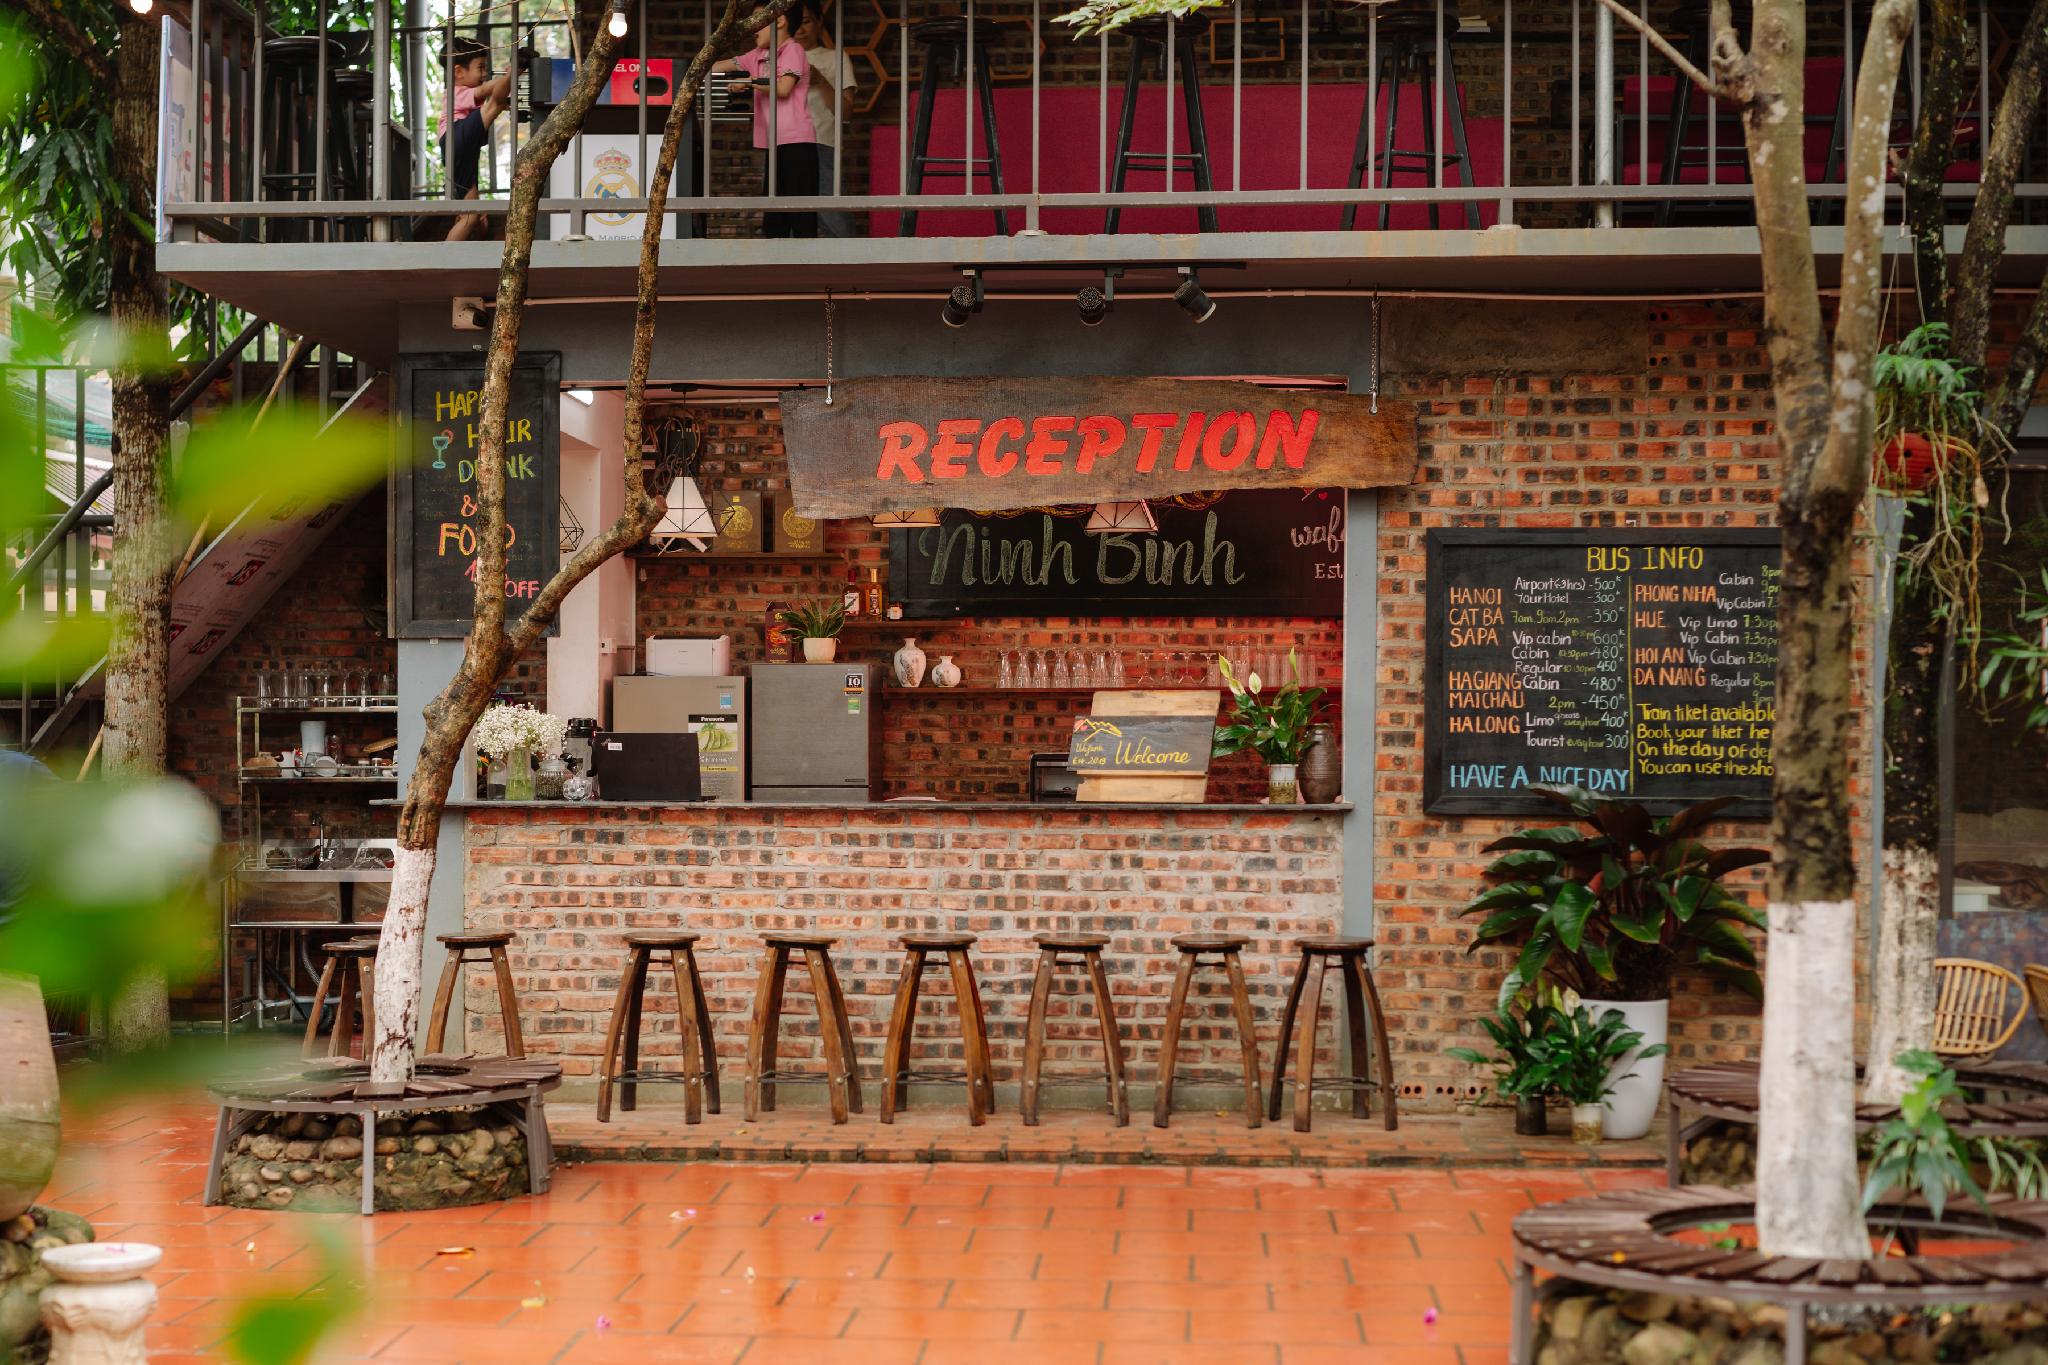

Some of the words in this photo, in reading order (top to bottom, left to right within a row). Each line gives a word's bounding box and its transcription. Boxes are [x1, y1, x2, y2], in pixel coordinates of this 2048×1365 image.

[876, 409, 1320, 483] RECEPTION
[460, 494, 477, 516] &
[918, 515, 1080, 586] Ninh
[1587, 547, 1631, 572] BUS
[1641, 547, 1704, 571] INFO
[1718, 572, 1754, 586] Cabin
[505, 580, 539, 599] OFF
[1450, 587, 1502, 605] HANOI
[1634, 584, 1679, 602] PHONG
[1682, 585, 1717, 603] NHA
[1449, 608, 1479, 625] CAT
[1483, 608, 1505, 625] BA
[1635, 611, 1665, 628] HUE
[1679, 616, 1701, 631] Vip
[1706, 616, 1738, 628] Limo
[1449, 628, 1499, 647] SAPA
[1512, 630, 1533, 650] Vip
[1679, 631, 1700, 649] Vip
[1704, 630, 1740, 645] Cabin
[1511, 646, 1549, 660] Cabin
[1634, 647, 1658, 664] HOI
[1661, 647, 1684, 664] AN
[1687, 649, 1707, 668] Vip
[1710, 648, 1746, 665] Cabin
[1515, 659, 1562, 678] Regular
[1658, 667, 1706, 686] NANG
[847, 677, 861, 686] 10
[1522, 675, 1560, 690] Cabin
[1710, 671, 1751, 693] Regular
[1548, 696, 1575, 712] 2pm
[1636, 703, 1671, 720] Train
[1525, 711, 1555, 727] Limo
[1523, 730, 1565, 747] Tourist
[1636, 723, 1671, 739] Book
[1675, 728, 1707, 741] your
[1115, 736, 1191, 766] Welcome
[1636, 741, 1658, 757] On
[1662, 739, 1688, 756] the
[1690, 740, 1724, 761] day
[1727, 743, 1748, 758] of
[1638, 759, 1664, 774] You
[1664, 763, 1692, 774] can
[1695, 762, 1721, 774] use
[1450, 764, 1507, 789] HAVE
[1510, 765, 1530, 789] A
[1587, 767, 1630, 791] DAY
